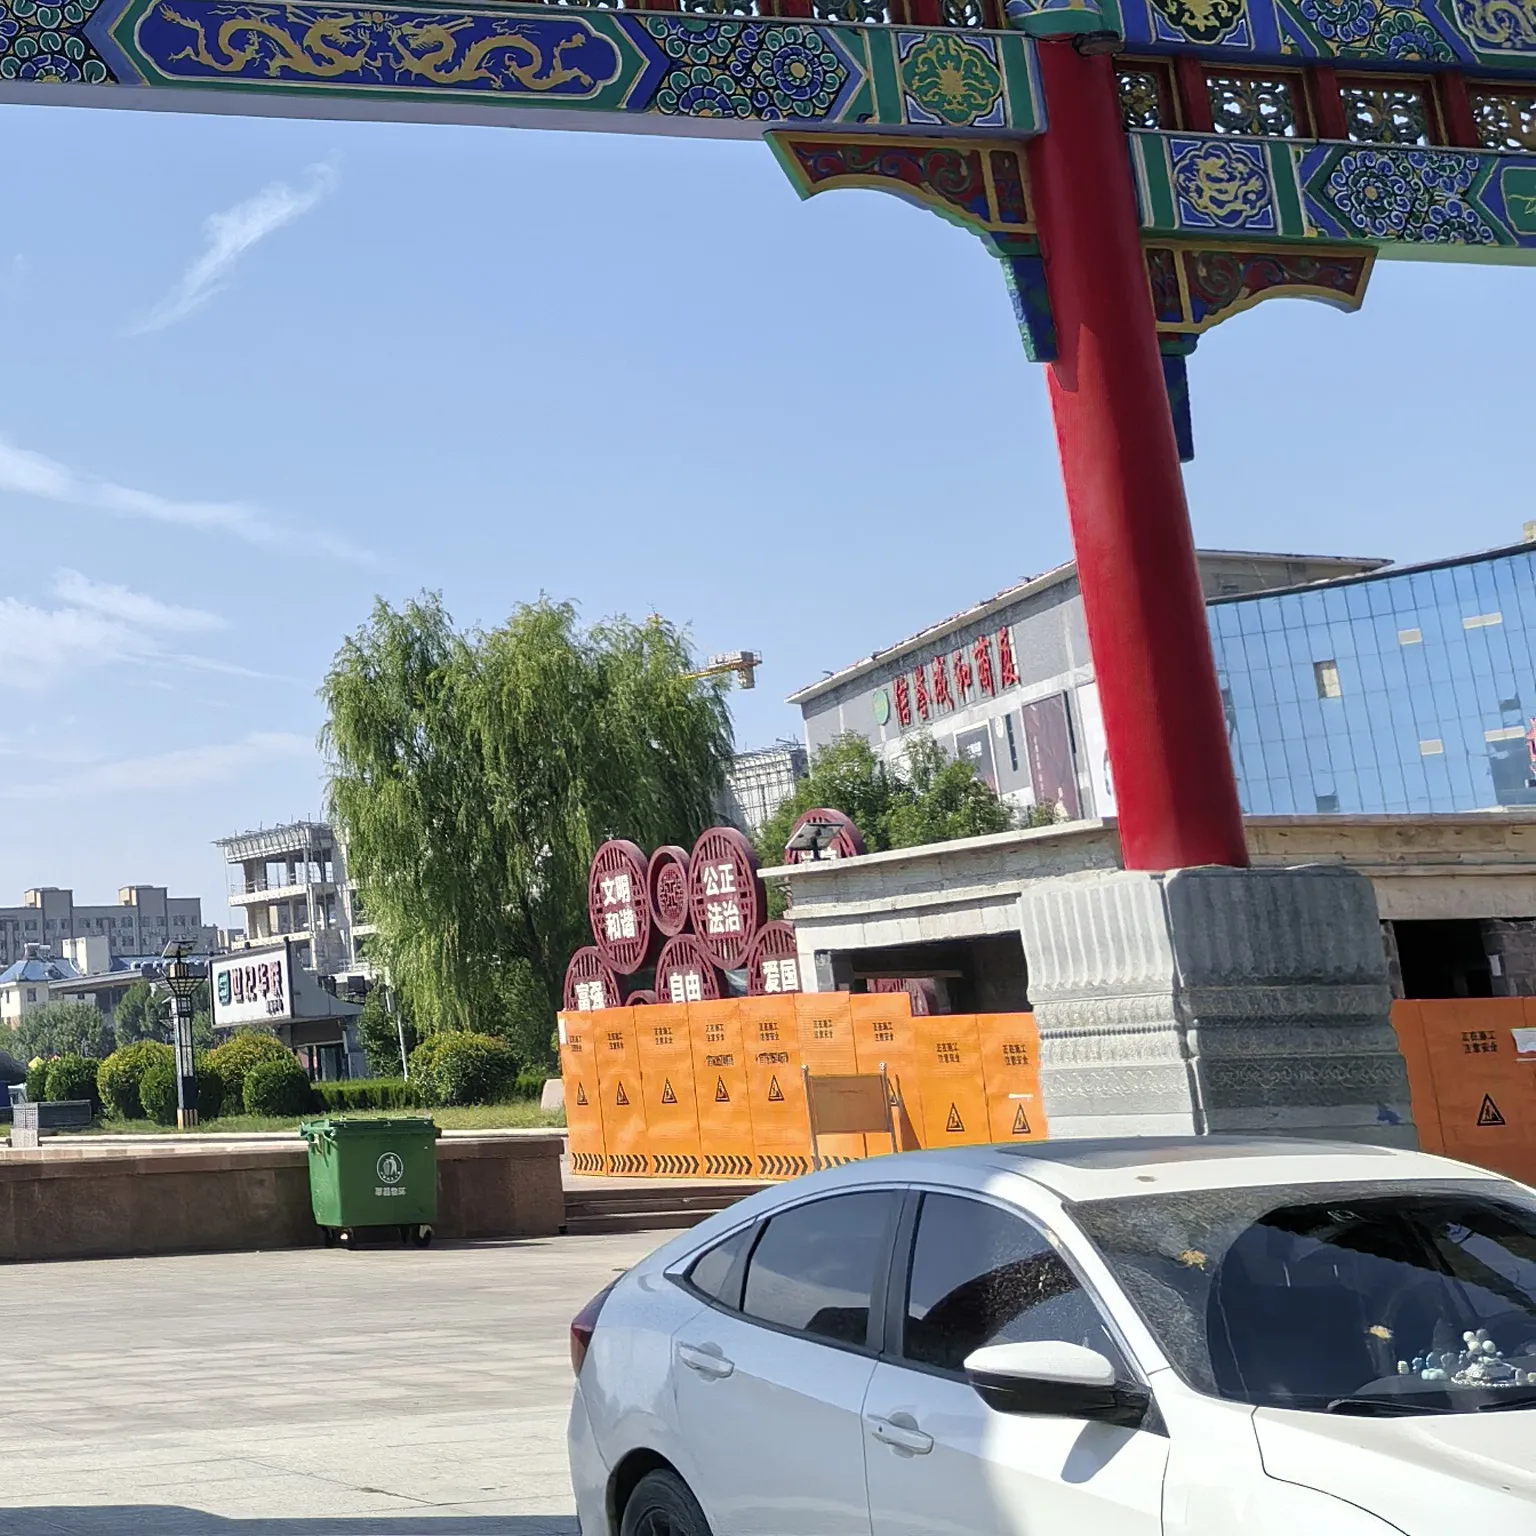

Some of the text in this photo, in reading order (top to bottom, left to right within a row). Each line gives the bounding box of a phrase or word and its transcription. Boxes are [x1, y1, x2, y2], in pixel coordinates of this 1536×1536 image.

[600, 873, 631, 907] 文明
[702, 863, 737, 896] 公正
[604, 908, 636, 941] 和谐
[707, 901, 741, 934] 法治
[669, 970, 702, 1003] 自由
[762, 958, 799, 993] 爱国
[574, 980, 605, 1011] 富强
